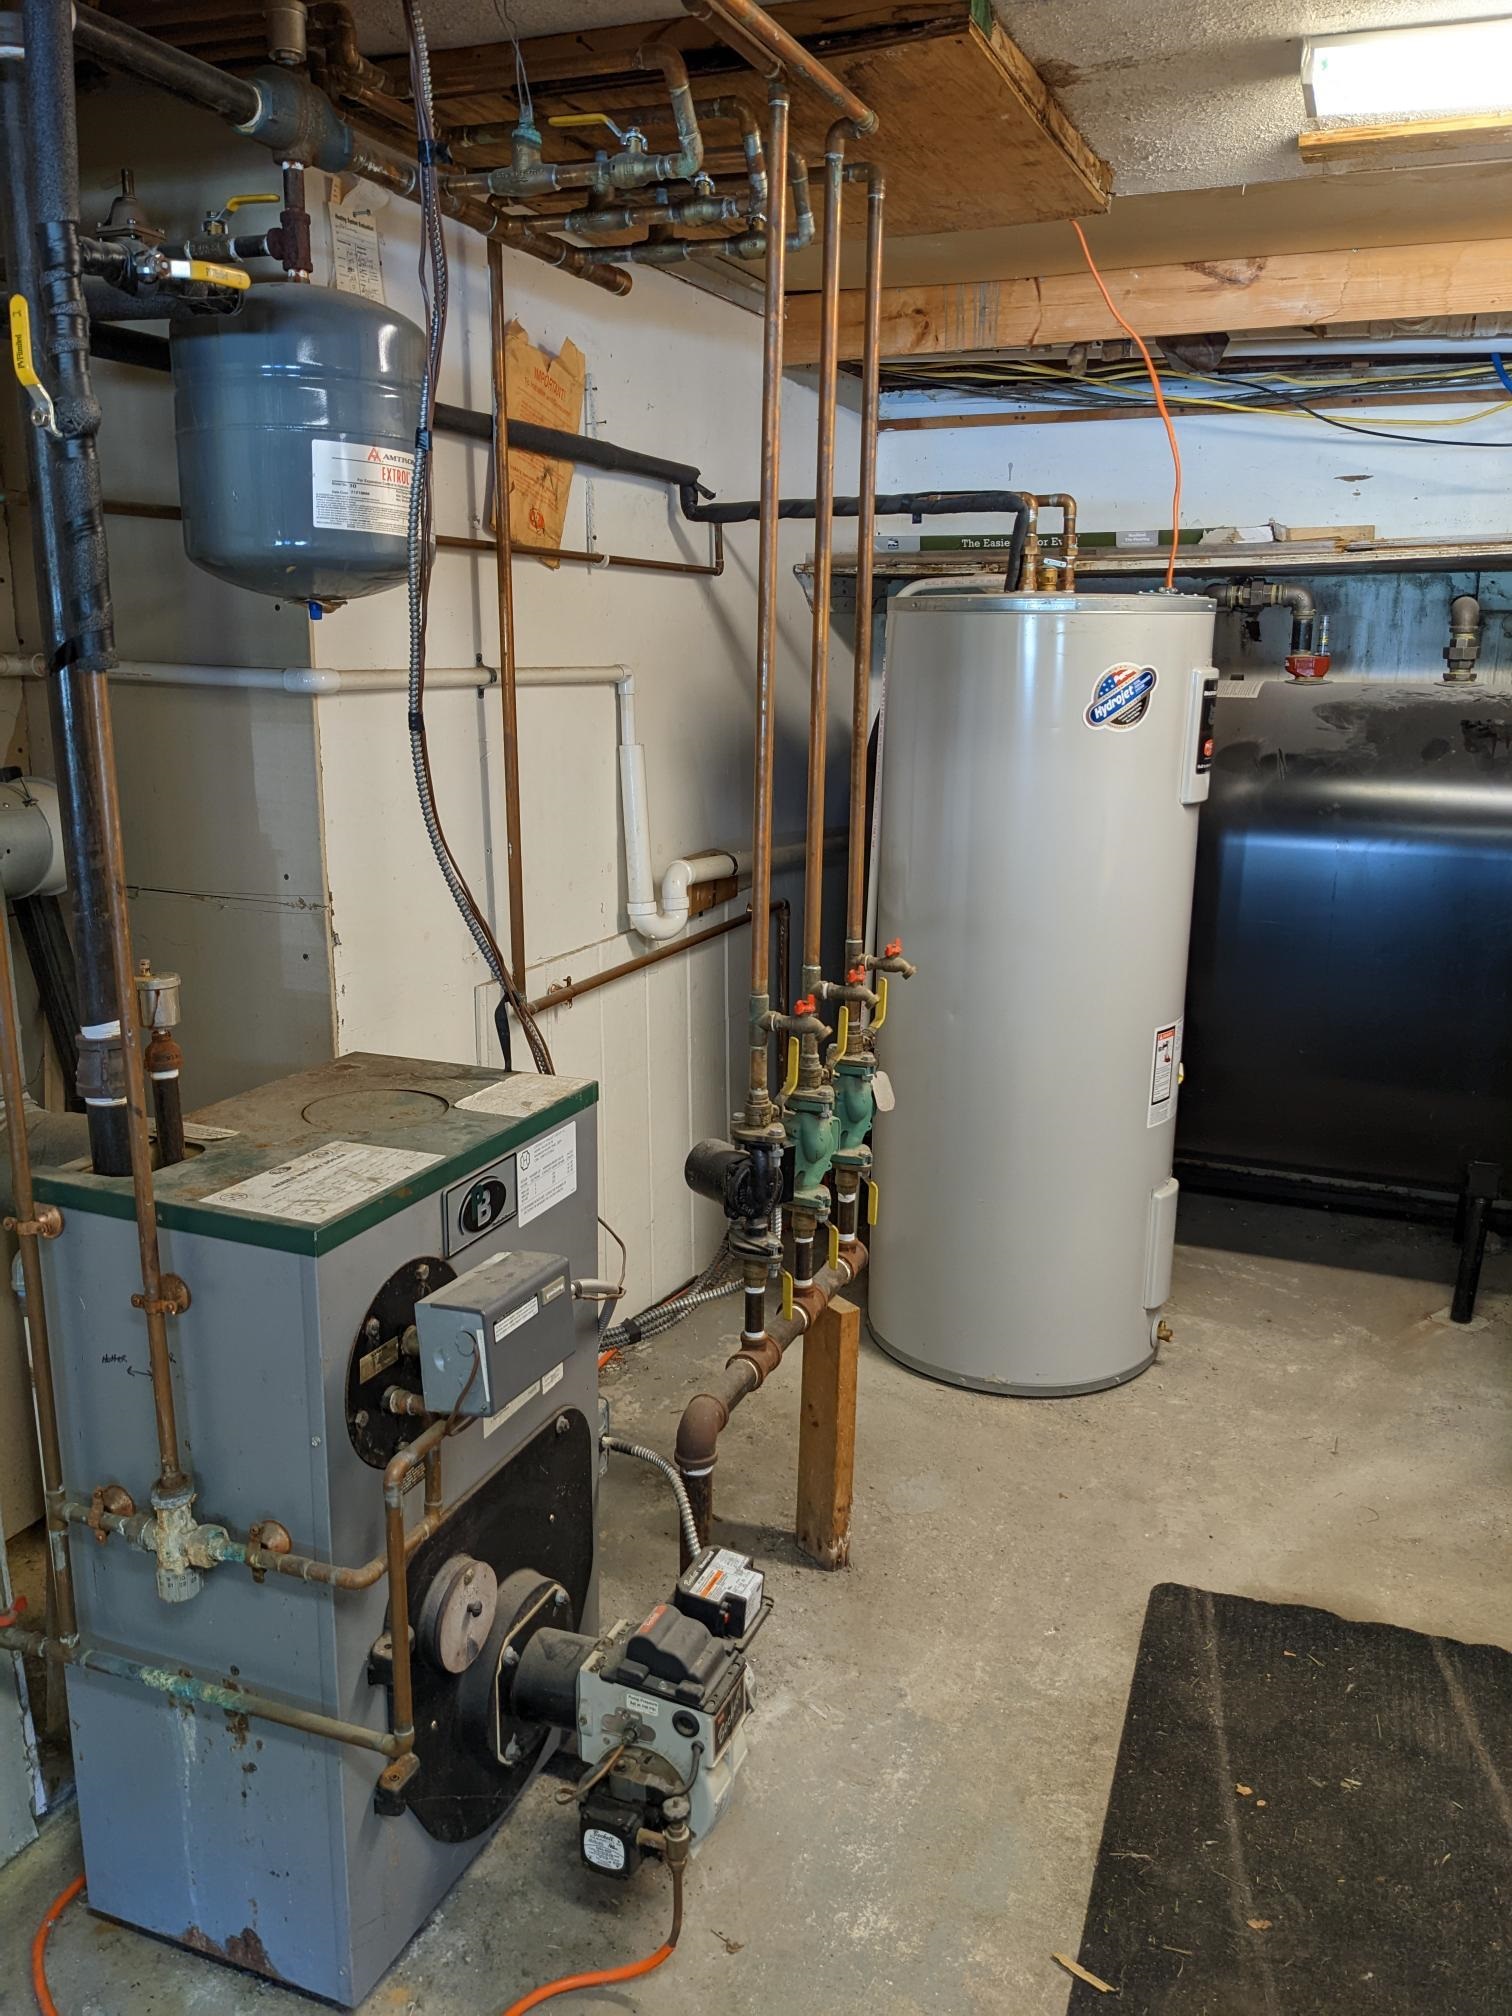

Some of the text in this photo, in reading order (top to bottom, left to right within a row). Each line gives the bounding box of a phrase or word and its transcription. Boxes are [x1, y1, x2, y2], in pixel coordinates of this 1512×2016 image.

[381, 466, 411, 486] EXTROL
[961, 538, 981, 548] The
[983, 538, 1011, 548] Easie
[1093, 684, 1135, 720] Hydrojet
